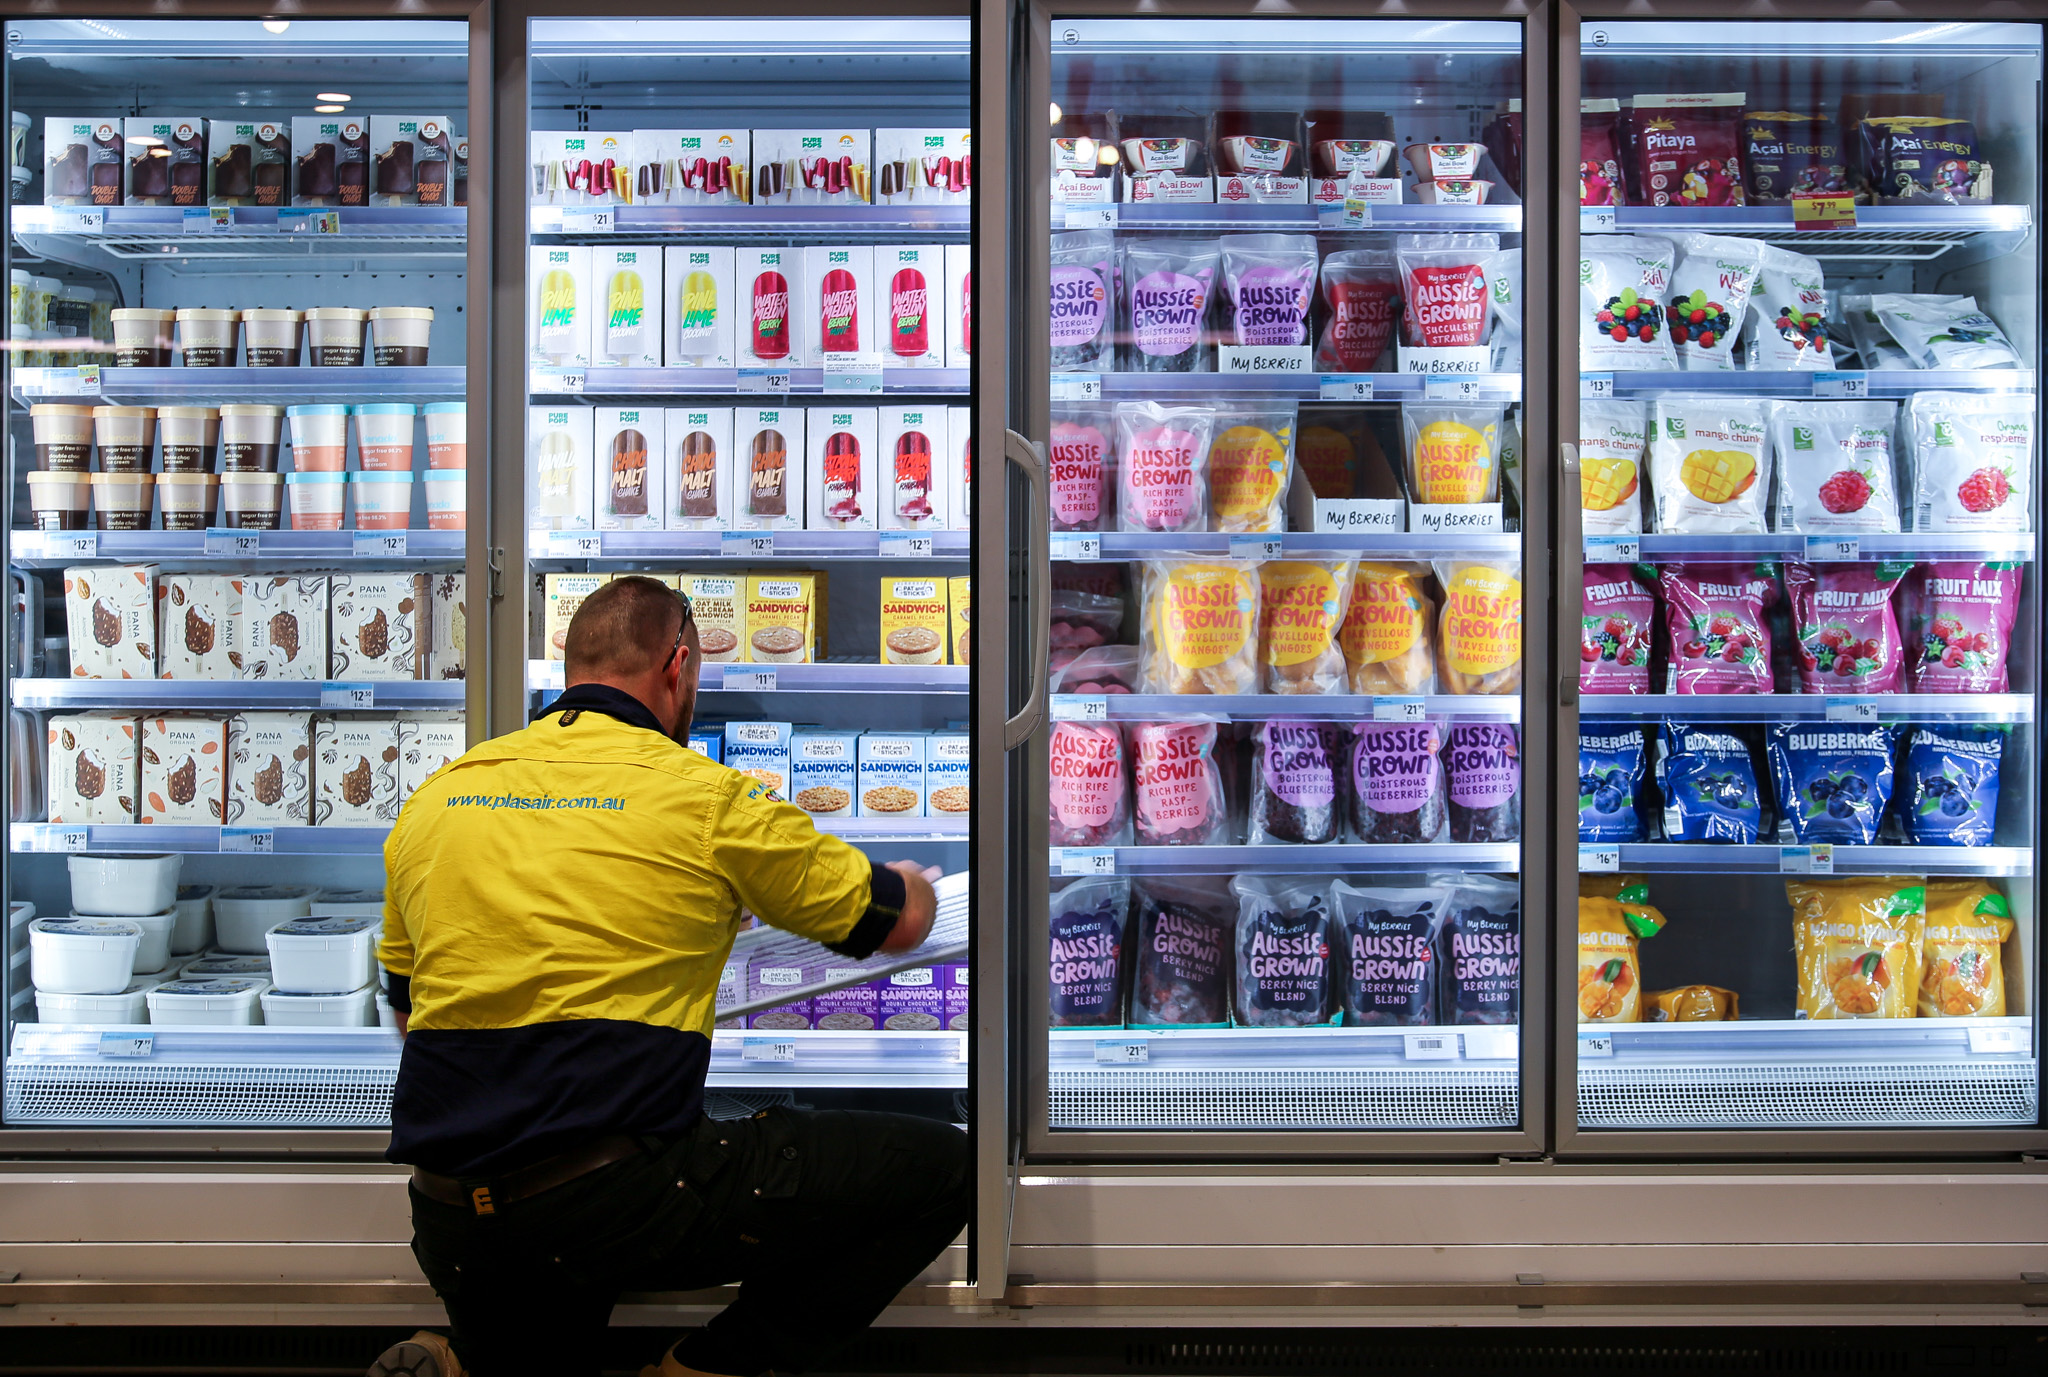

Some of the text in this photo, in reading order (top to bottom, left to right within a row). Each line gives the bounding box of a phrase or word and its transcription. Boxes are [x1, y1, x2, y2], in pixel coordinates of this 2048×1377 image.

[1646, 133, 1696, 151] Pitaya
[1890, 136, 1971, 155] Açaí Energy
[1750, 142, 1838, 158] Açaí Energy
[171, 184, 199, 194] DOUBLE
[416, 182, 444, 193] DOUBLE
[1080, 182, 1102, 191] Bowl
[1181, 180, 1203, 189] Bowl
[420, 192, 440, 201] CHOC
[594, 213, 608, 225] $21
[1101, 211, 1111, 222] $6
[754, 291, 788, 309] WATER
[892, 288, 927, 307] WATER
[1134, 288, 1196, 310] AUSSIE
[1418, 282, 1480, 306] AUSSIE
[752, 302, 788, 321] MELON
[891, 300, 926, 319] MELON
[1418, 302, 1482, 324] GROWN
[609, 308, 643, 328] LIME
[682, 308, 717, 328] LIME
[758, 318, 782, 331] BERRY
[897, 315, 921, 328] BERRY
[1134, 308, 1197, 329] GROWN
[1138, 326, 1191, 336] BOISTEROUS
[1138, 336, 1193, 346] BLUEBERRIES
[1432, 333, 1475, 344] STRAWBS
[1232, 356, 1302, 372] My BERRIES
[1410, 360, 1480, 374] My BERRIES
[766, 375, 788, 386] $12.95
[1610, 426, 1645, 441] Organic
[1695, 429, 1729, 440] mango
[612, 449, 648, 472] CHOC
[681, 451, 716, 474] CHOC
[1132, 448, 1192, 469] AUSSIE
[611, 466, 648, 489] MALT
[680, 468, 716, 491] MALT
[1132, 468, 1192, 488] GROWN
[1143, 488, 1184, 498] RICH RIPE
[1146, 508, 1184, 518] BERRIES
[1327, 512, 1396, 530] My BERRIES
[1422, 512, 1494, 531] My BERRIES
[360, 585, 386, 593] PANA
[1585, 580, 1628, 600] FRUIT
[1925, 578, 2003, 598] FRUIT MIX
[1170, 582, 1241, 609] AUSSIE
[1814, 588, 1891, 607] FRUIT MIX
[748, 604, 810, 614] SANDWICH
[883, 604, 946, 614] SANDWICH
[1169, 609, 1243, 630] GROWN
[1174, 632, 1240, 643] MARVELLOUS
[1182, 644, 1229, 656] MANGOES
[1451, 640, 1518, 653] MARVELLOUS
[1457, 652, 1506, 664] MANGOES
[755, 673, 775, 684] $11.99
[350, 690, 372, 702] $12.50
[170, 732, 196, 740] PANA
[256, 732, 282, 740] PANA
[1789, 733, 1888, 750] BLUEBERRIES
[726, 746, 788, 757] SANDWICH
[1052, 732, 1116, 760] AUSSIE
[792, 764, 854, 774] SANDWICH
[860, 763, 922, 774] SANDWICH
[1051, 757, 1119, 779] GROWN
[1062, 781, 1109, 792] RICH RIPE
[1364, 778, 1427, 788] BOISTEROUS
[1362, 788, 1429, 800] BLUEBERRIES
[447, 793, 626, 810] www.plasair.com.au
[1064, 804, 1108, 815] BERRIES
[1810, 924, 1856, 938] MANGO
[1050, 933, 1114, 962] AUSSIE
[1352, 934, 1426, 958] AUSSIE
[1050, 958, 1116, 984] GROWN
[1352, 960, 1426, 980] GROWN
[880, 990, 942, 1000] SANDWICH
[1060, 982, 1112, 996] BERRY NICE
[1360, 983, 1420, 994] BERRY NICE
[1074, 996, 1103, 1007] BLEND
[1374, 994, 1407, 1004] BLEND
